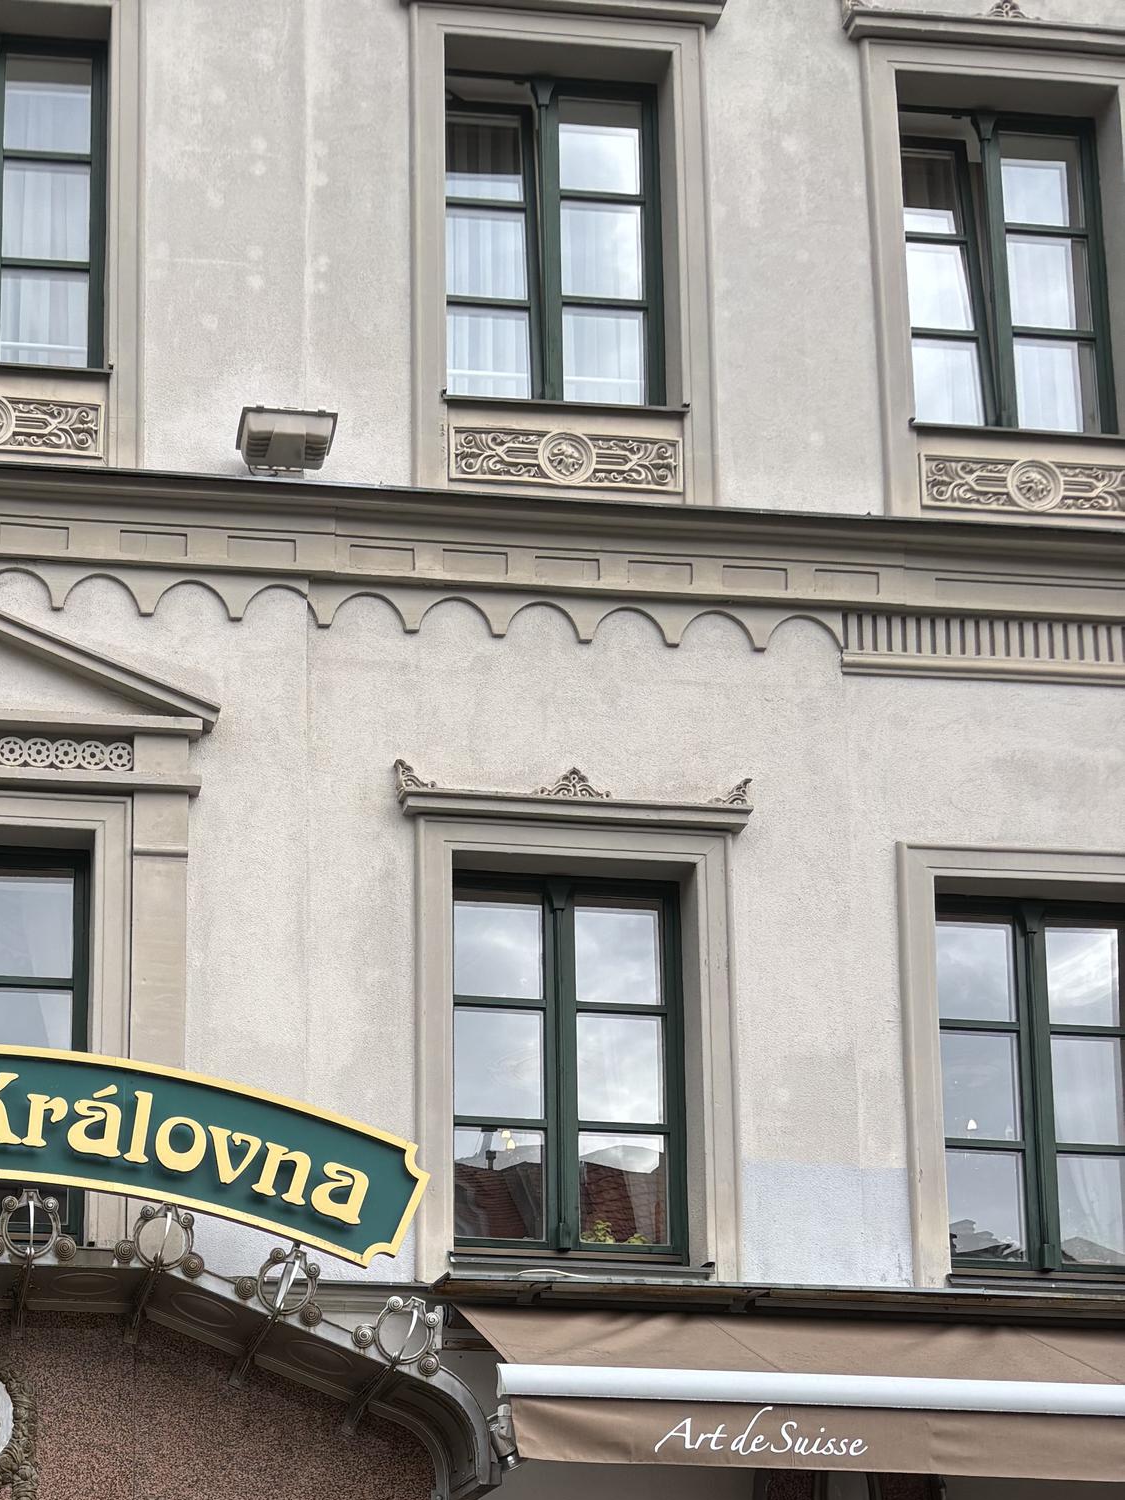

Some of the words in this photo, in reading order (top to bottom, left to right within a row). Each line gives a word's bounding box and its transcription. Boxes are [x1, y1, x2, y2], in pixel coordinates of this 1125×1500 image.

[654, 1417, 727, 1453] Art
[730, 1406, 773, 1456] de
[770, 1421, 868, 1456] Suisse
